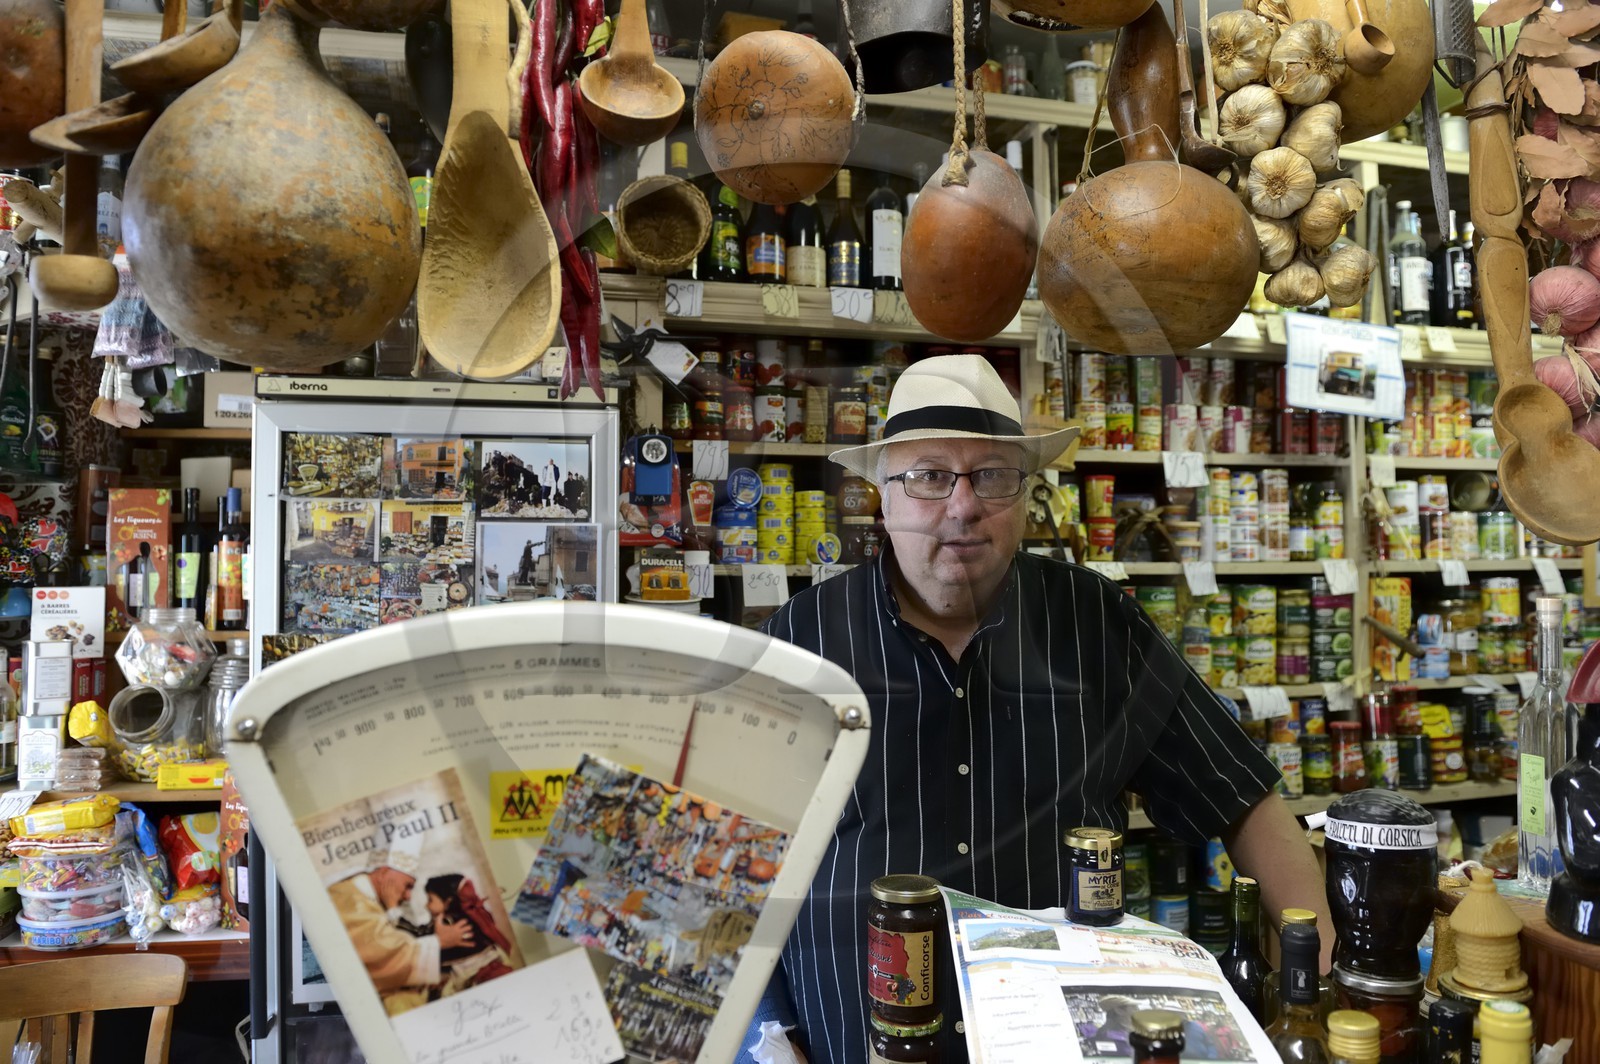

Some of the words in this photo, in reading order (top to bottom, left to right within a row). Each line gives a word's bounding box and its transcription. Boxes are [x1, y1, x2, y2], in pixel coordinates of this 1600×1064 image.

[641, 558, 683, 566] DURACELL
[514, 659, 523, 670] 5
[527, 656, 602, 670] GRAMMES
[354, 719, 377, 736] 900
[403, 704, 426, 720] 800
[453, 694, 475, 708] 700
[741, 712, 760, 727] 100
[786, 730, 798, 745] 0
[302, 799, 416, 848] Bienheureux
[321, 834, 377, 866] Jean
[381, 808, 434, 844] Paul
[438, 800, 460, 824] II
[1329, 820, 1357, 843] FRUTTI
[1362, 826, 1374, 845] DI
[1088, 874, 1117, 885] MYRTE
[32, 935, 62, 945] HARIBO
[920, 935, 930, 1001] Conficorse
